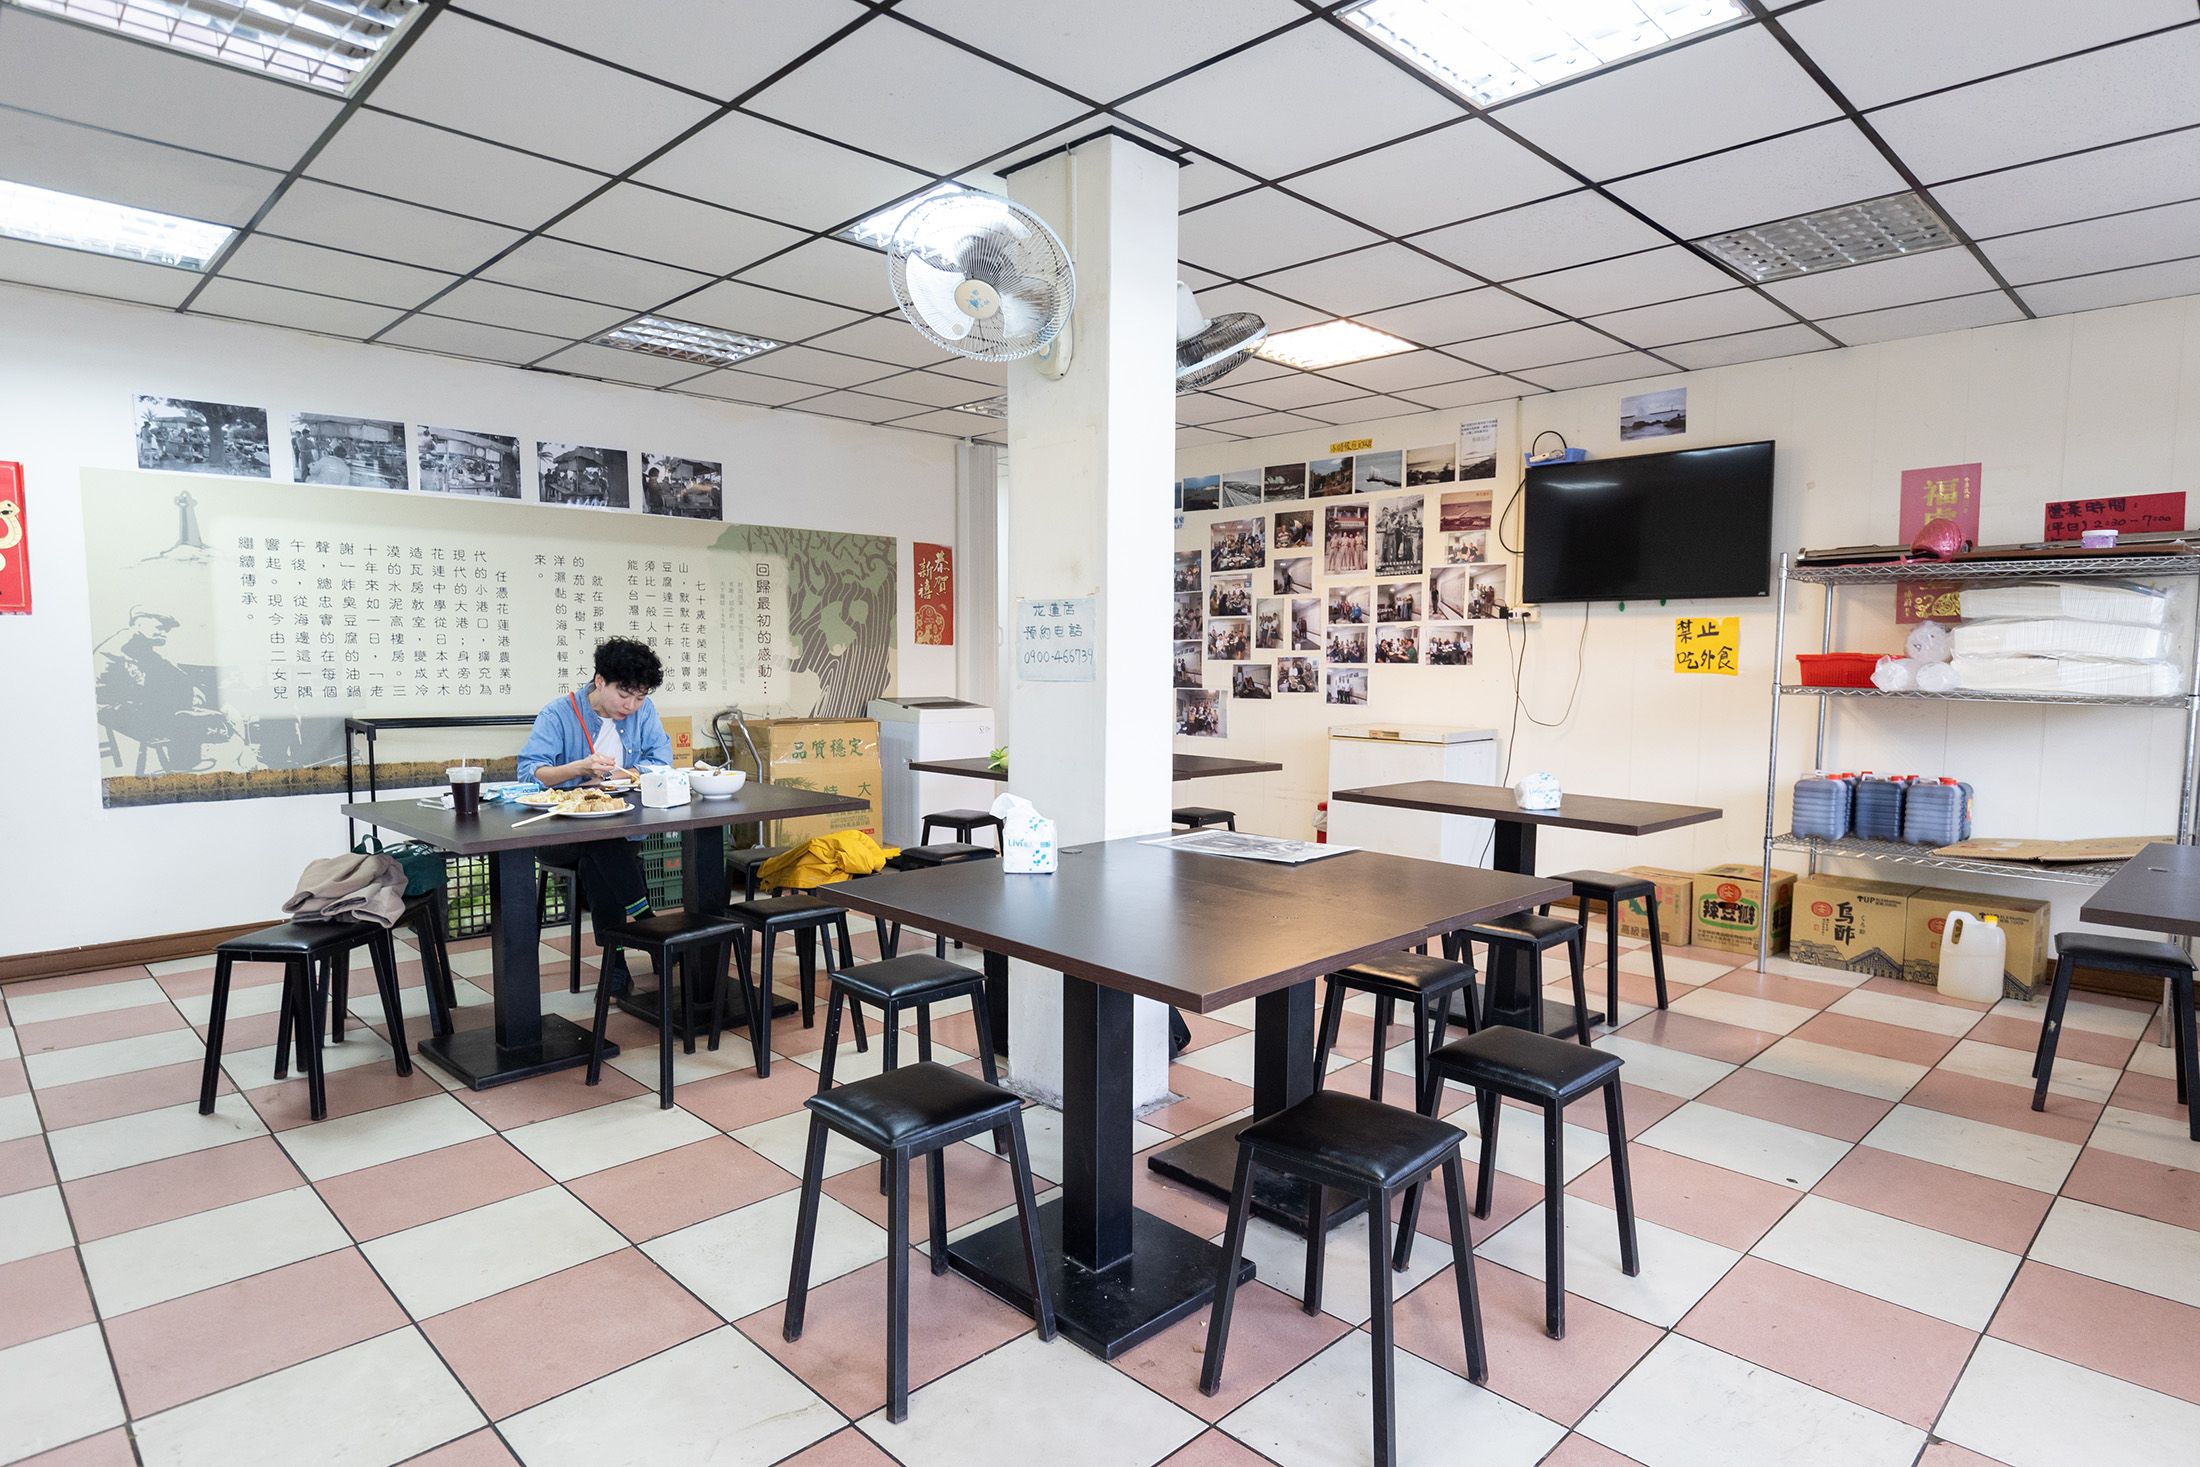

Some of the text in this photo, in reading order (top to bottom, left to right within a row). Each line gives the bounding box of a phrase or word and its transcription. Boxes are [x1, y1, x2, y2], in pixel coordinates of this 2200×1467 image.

[2047, 521, 2087, 536] (平日)
[238, 536, 258, 620] 繼續傳承。
[917, 557, 934, 600] 新禧
[933, 550, 950, 596] 恭賀
[495, 570, 512, 695] 任憑花蓮港農業時
[1676, 619, 1720, 644] 禁止
[1024, 648, 1094, 665] 0900-466739
[1676, 646, 1735, 671] 吃外食
[792, 737, 863, 760] 品質穩定
[1703, 899, 1755, 925] 辣豆瓣
[1621, 924, 1670, 942] 高級醬膏
